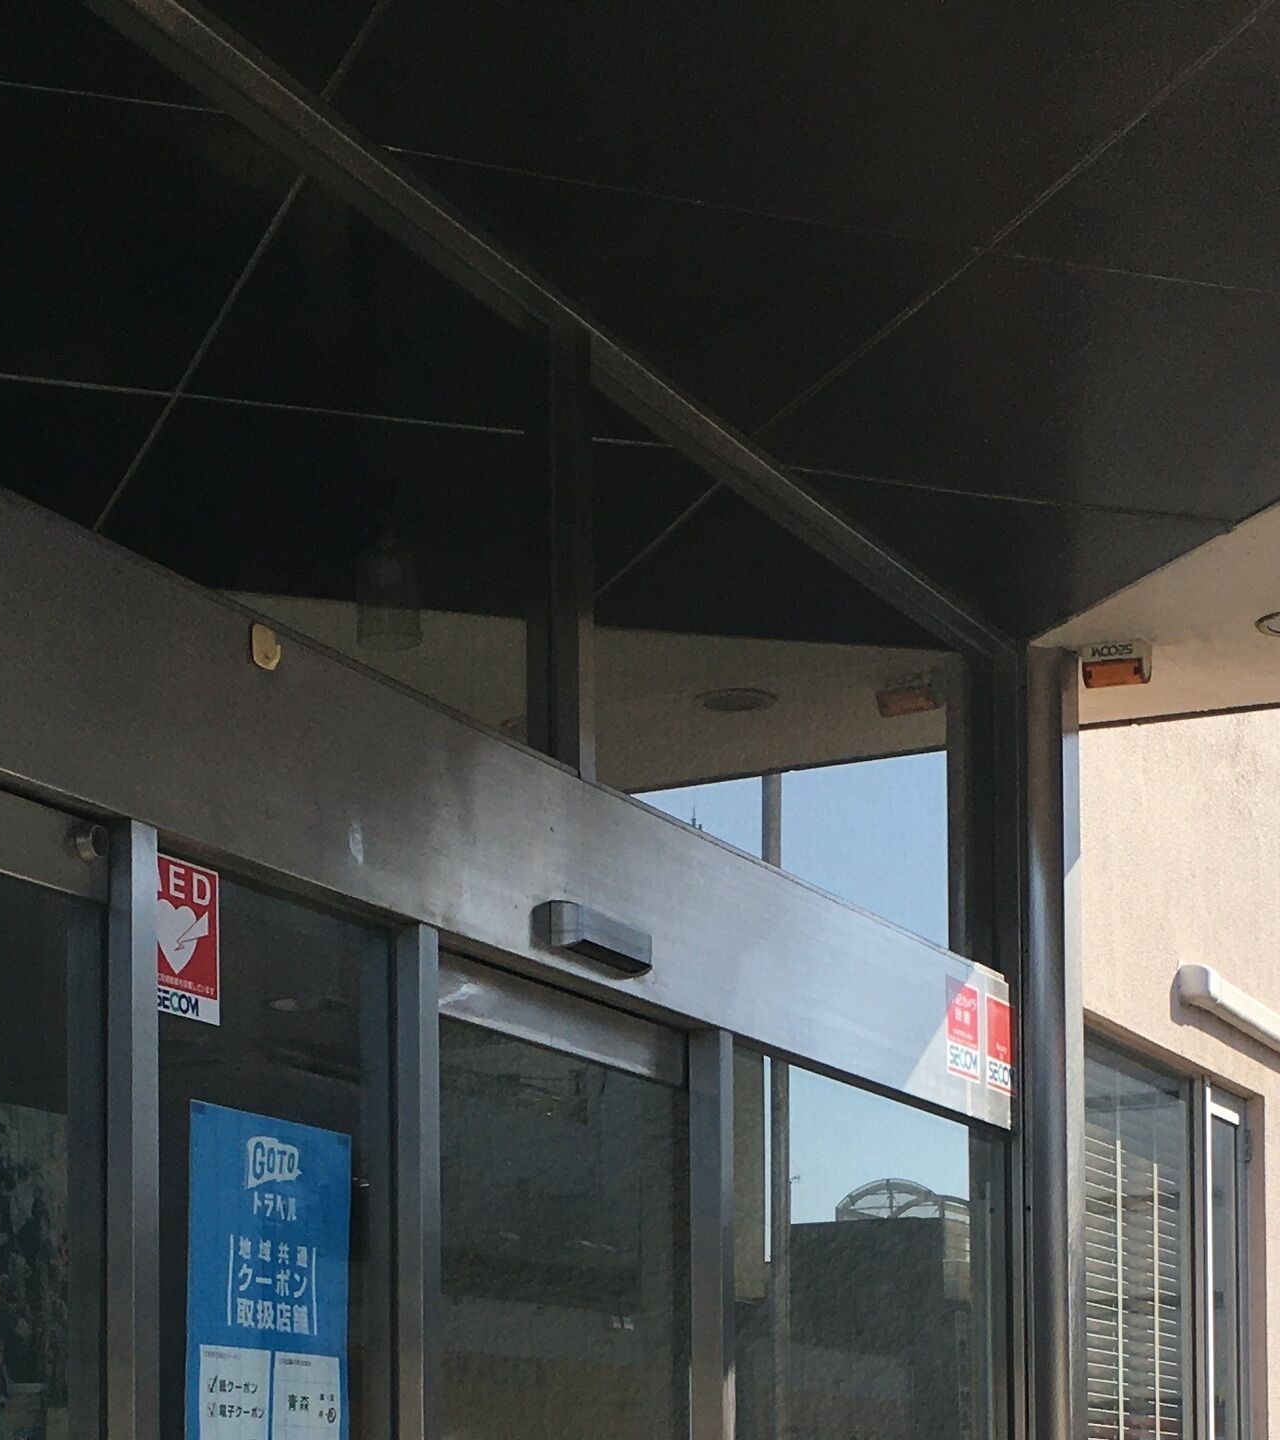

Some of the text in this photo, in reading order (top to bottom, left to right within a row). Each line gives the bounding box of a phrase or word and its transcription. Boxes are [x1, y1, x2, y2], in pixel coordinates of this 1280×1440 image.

[157, 863, 211, 906] ED
[949, 1044, 978, 1075] SECOM
[252, 1190, 297, 1222] トラベル
[238, 1235, 309, 1269] 地域共通
[238, 1263, 308, 1299] クーポン
[236, 1297, 310, 1336] 取扱店舗
[288, 1393, 310, 1412] 青森
